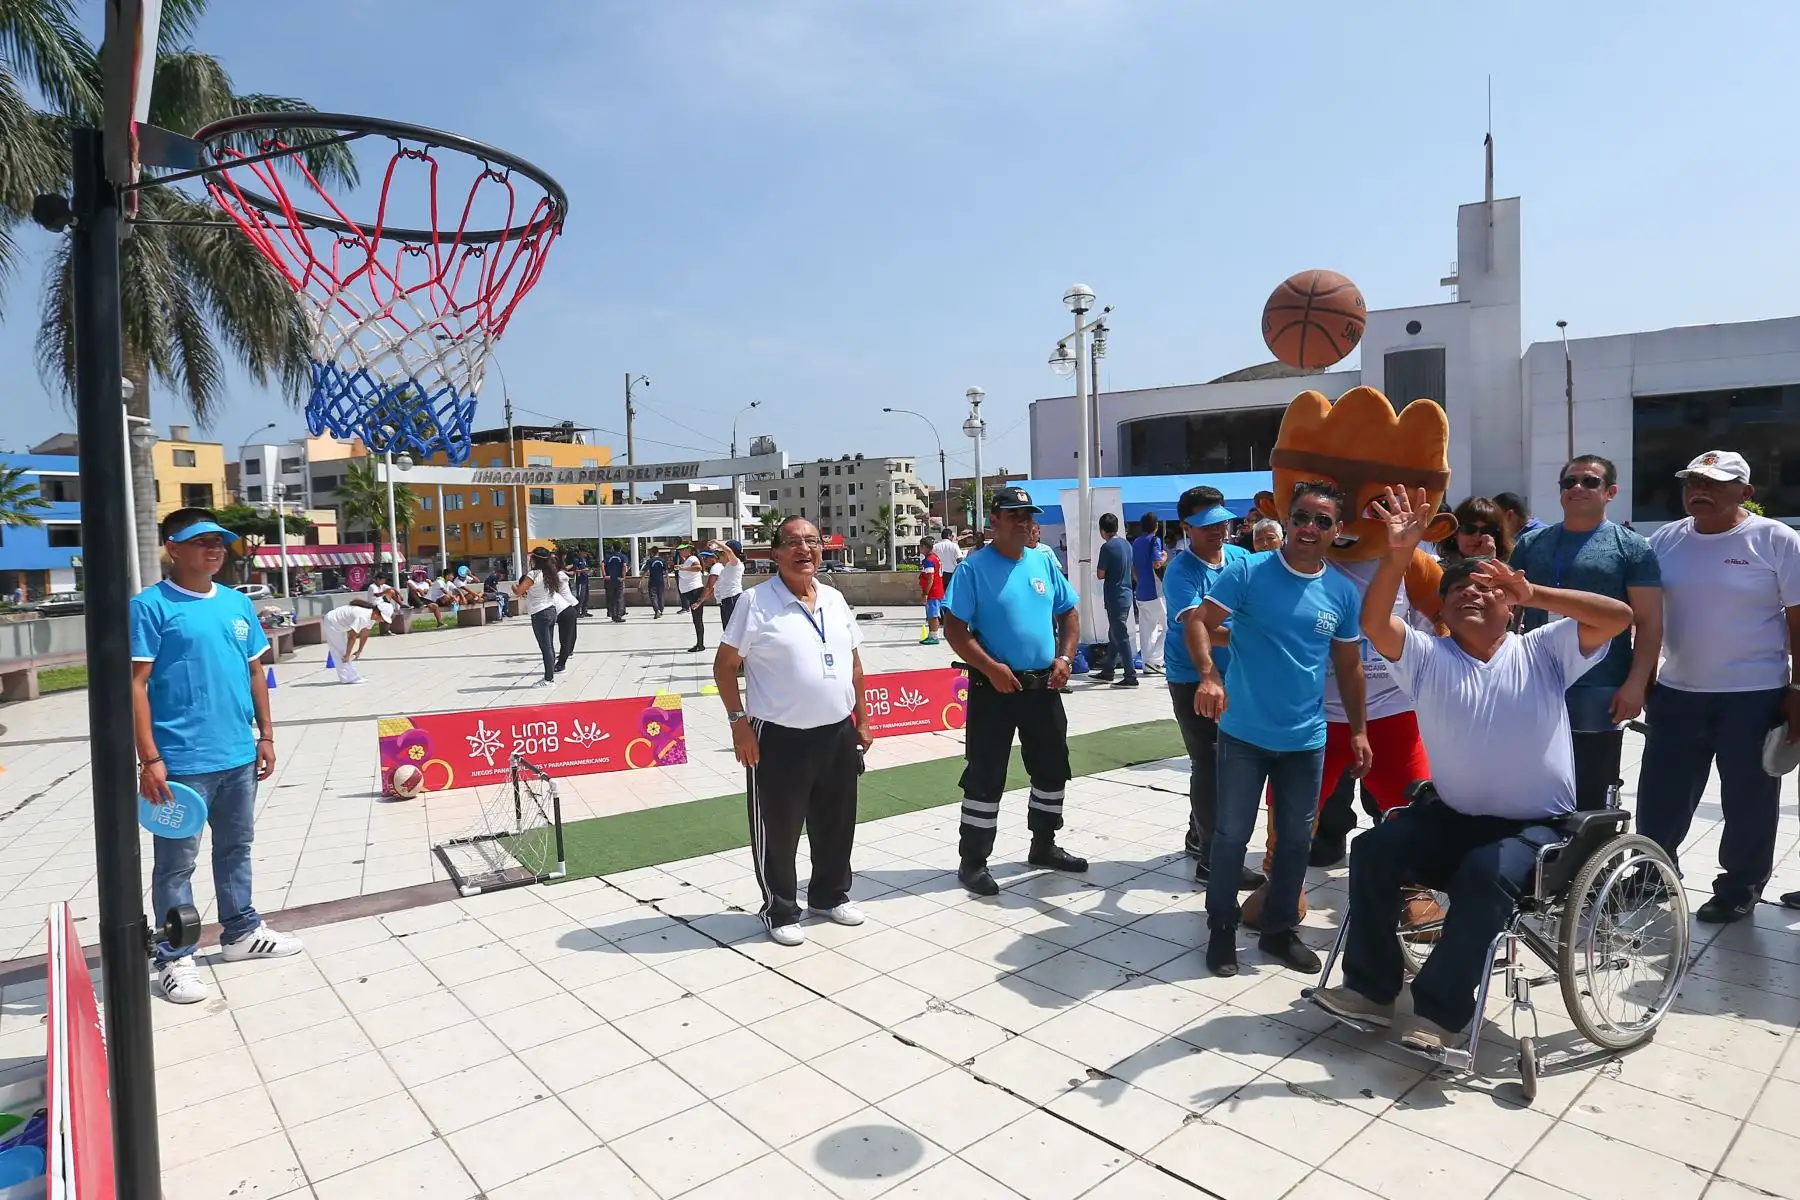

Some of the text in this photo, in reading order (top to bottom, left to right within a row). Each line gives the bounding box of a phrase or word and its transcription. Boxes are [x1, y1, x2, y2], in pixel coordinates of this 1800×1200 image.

[557, 470, 574, 483] LA
[577, 468, 621, 483] PERLA
[625, 466, 651, 481] DEL
[654, 463, 699, 478] PERU!!
[865, 700, 890, 716] 019
[512, 736, 559, 755] 2019
[471, 769, 493, 777] JUEGOS
[548, 756, 610, 769] PARAPANAMERICANOS
